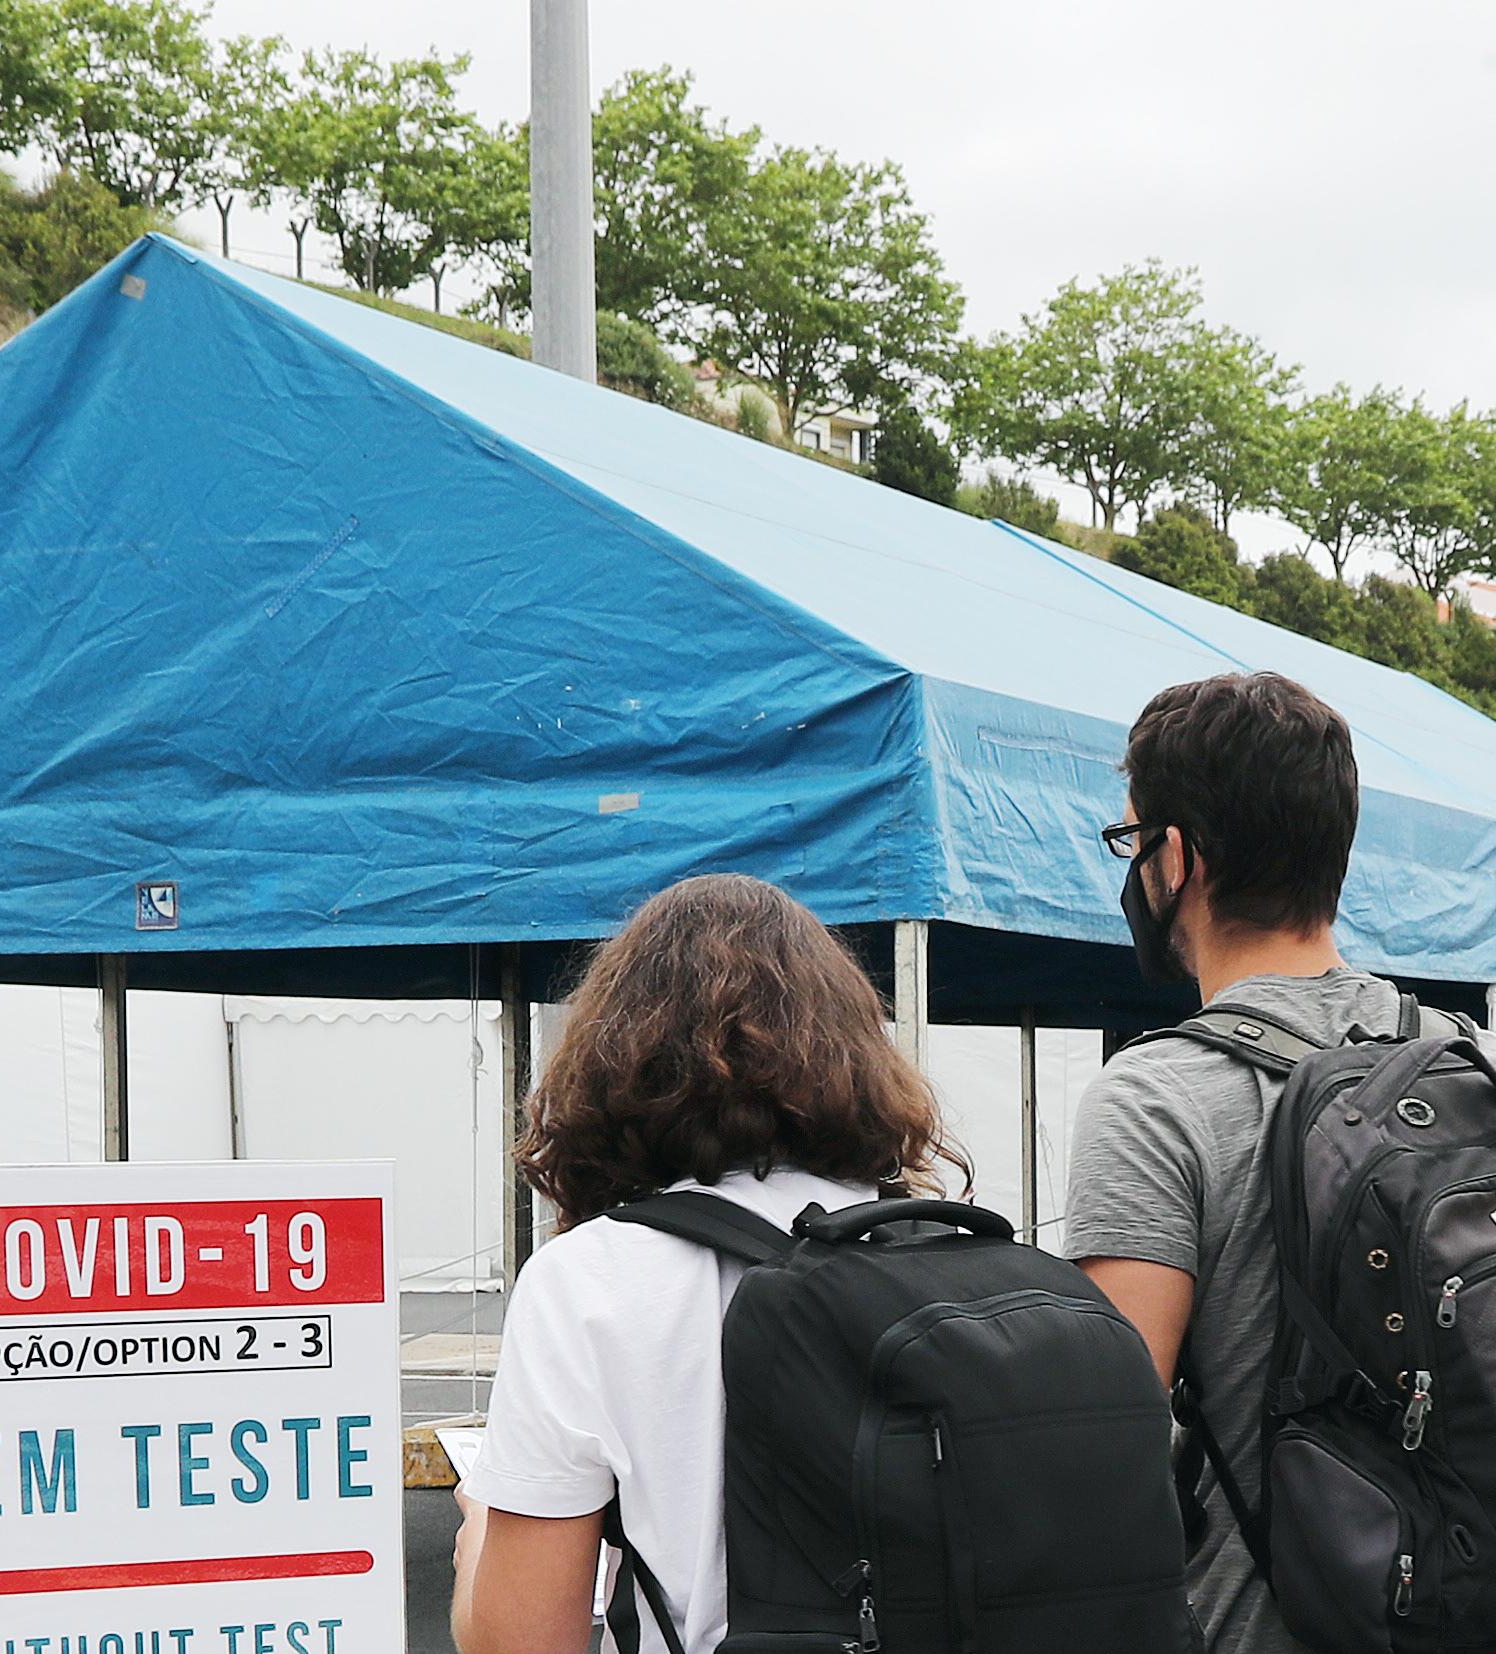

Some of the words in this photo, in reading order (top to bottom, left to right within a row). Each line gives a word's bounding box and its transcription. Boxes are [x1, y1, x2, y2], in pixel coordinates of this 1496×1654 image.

[234, 1325, 259, 1361] 2
[300, 1322, 324, 1358] 3
[120, 1414, 374, 1510] TESTE
